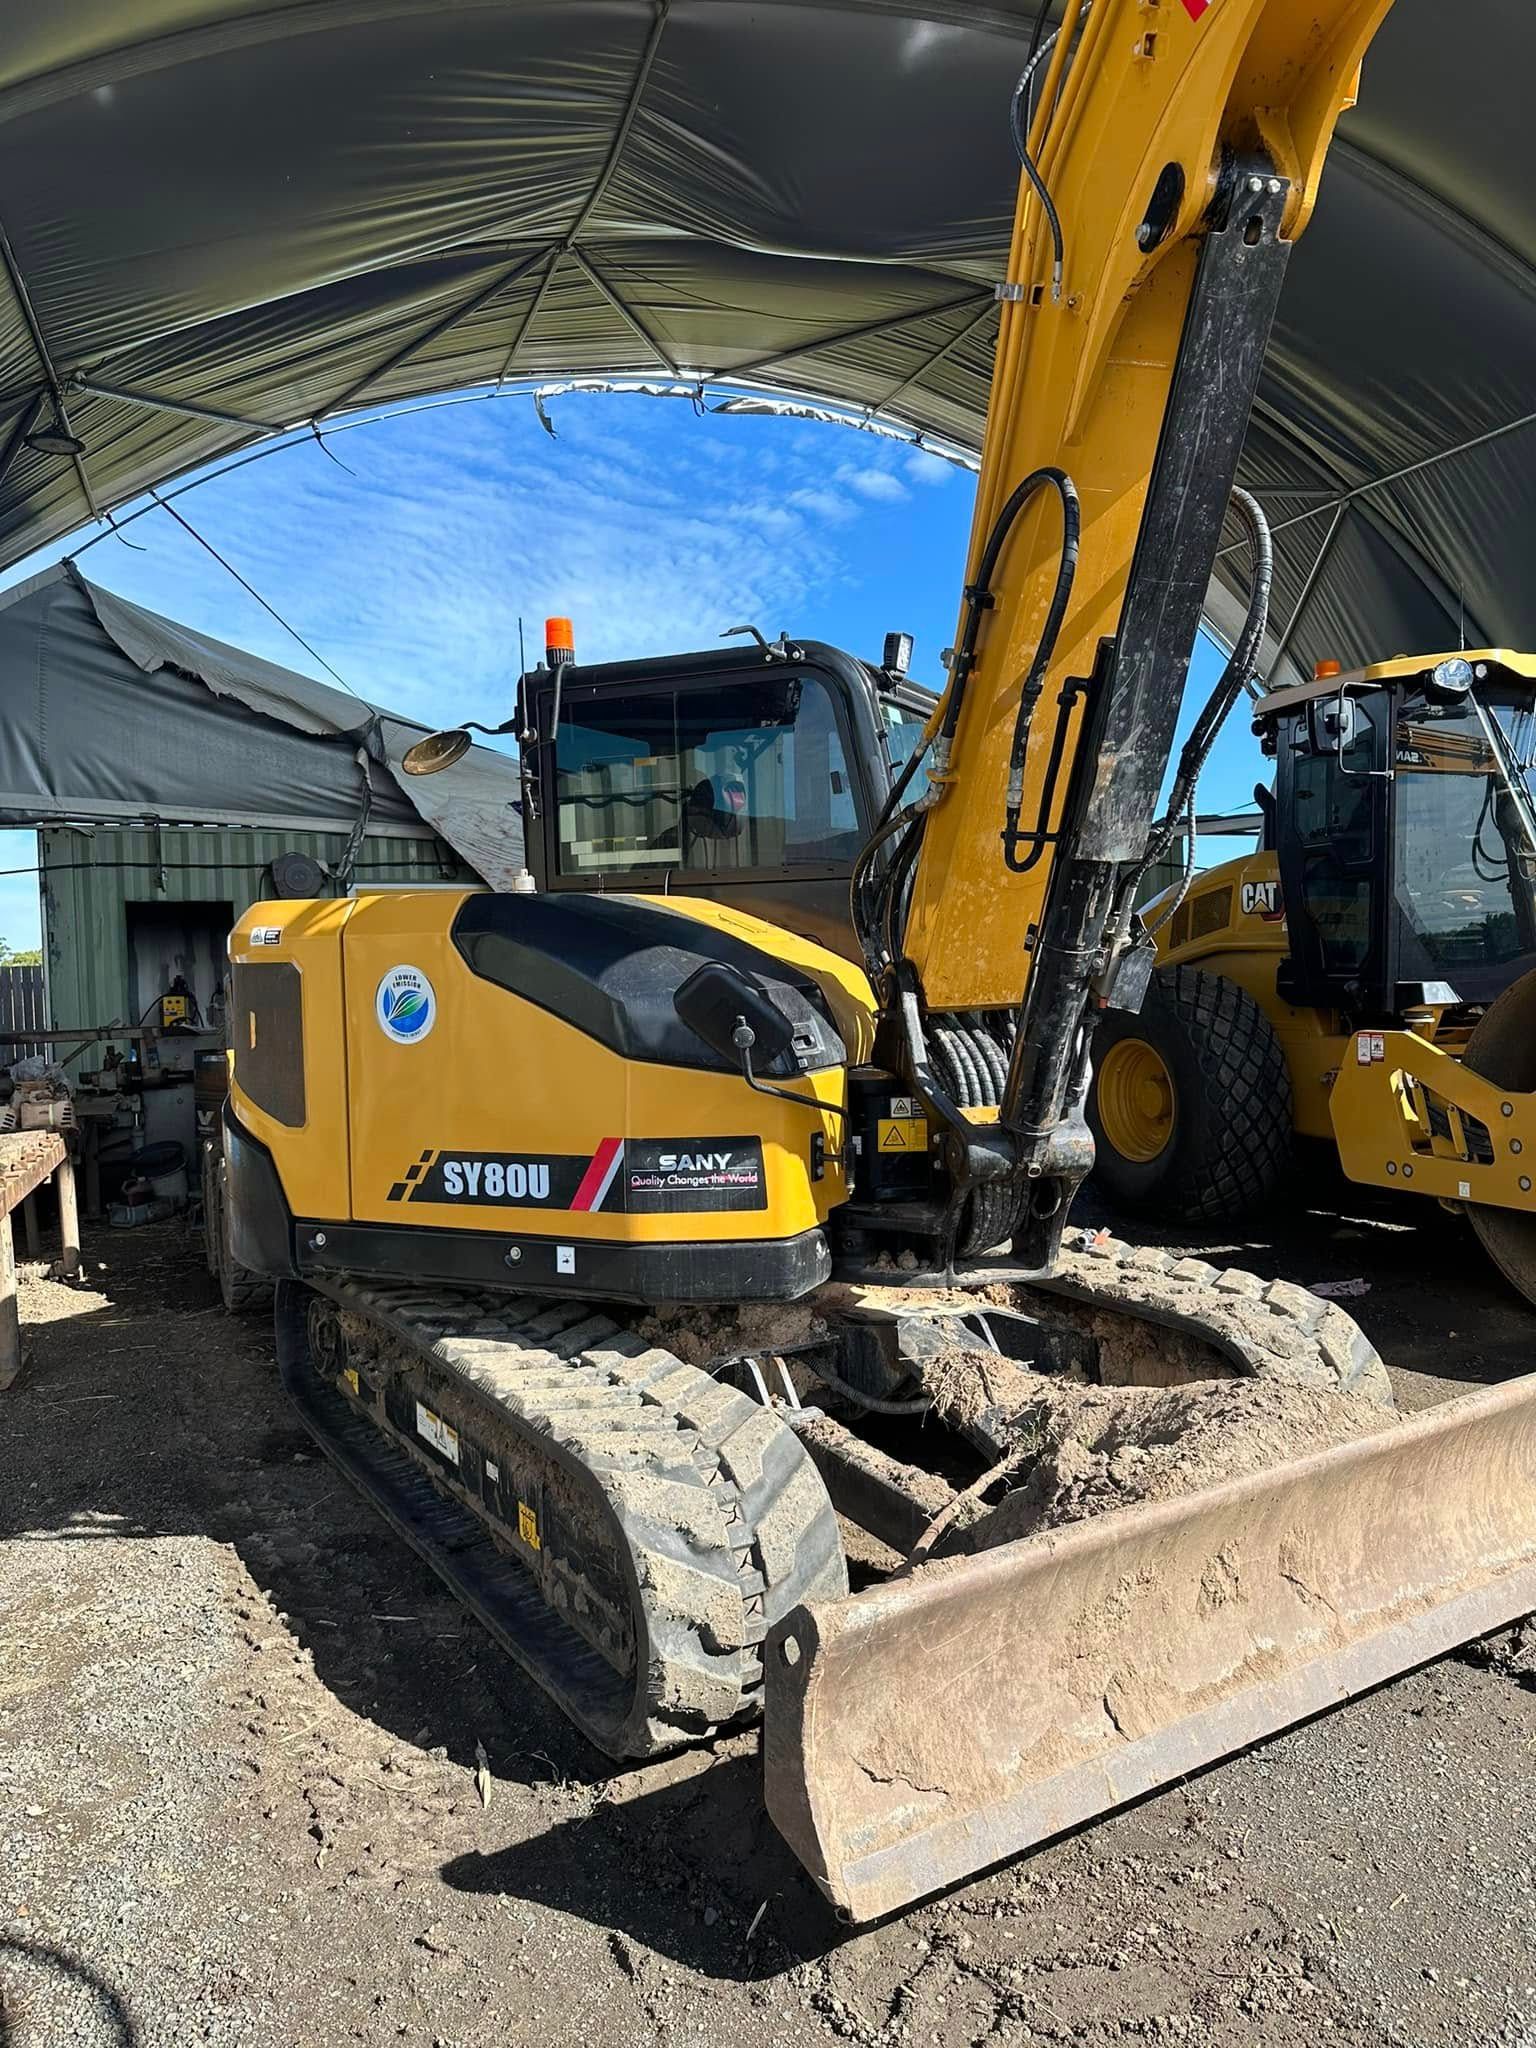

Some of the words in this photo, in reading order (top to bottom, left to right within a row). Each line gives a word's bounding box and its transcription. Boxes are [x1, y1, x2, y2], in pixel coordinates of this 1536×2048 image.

[1242, 882, 1277, 913] CAT
[659, 1153, 732, 1171] SANY
[443, 1161, 550, 1199] SY80U
[631, 1175, 665, 1188] Quality
[667, 1173, 709, 1186] Changes
[710, 1172, 726, 1184] the
[727, 1171, 758, 1183] World
